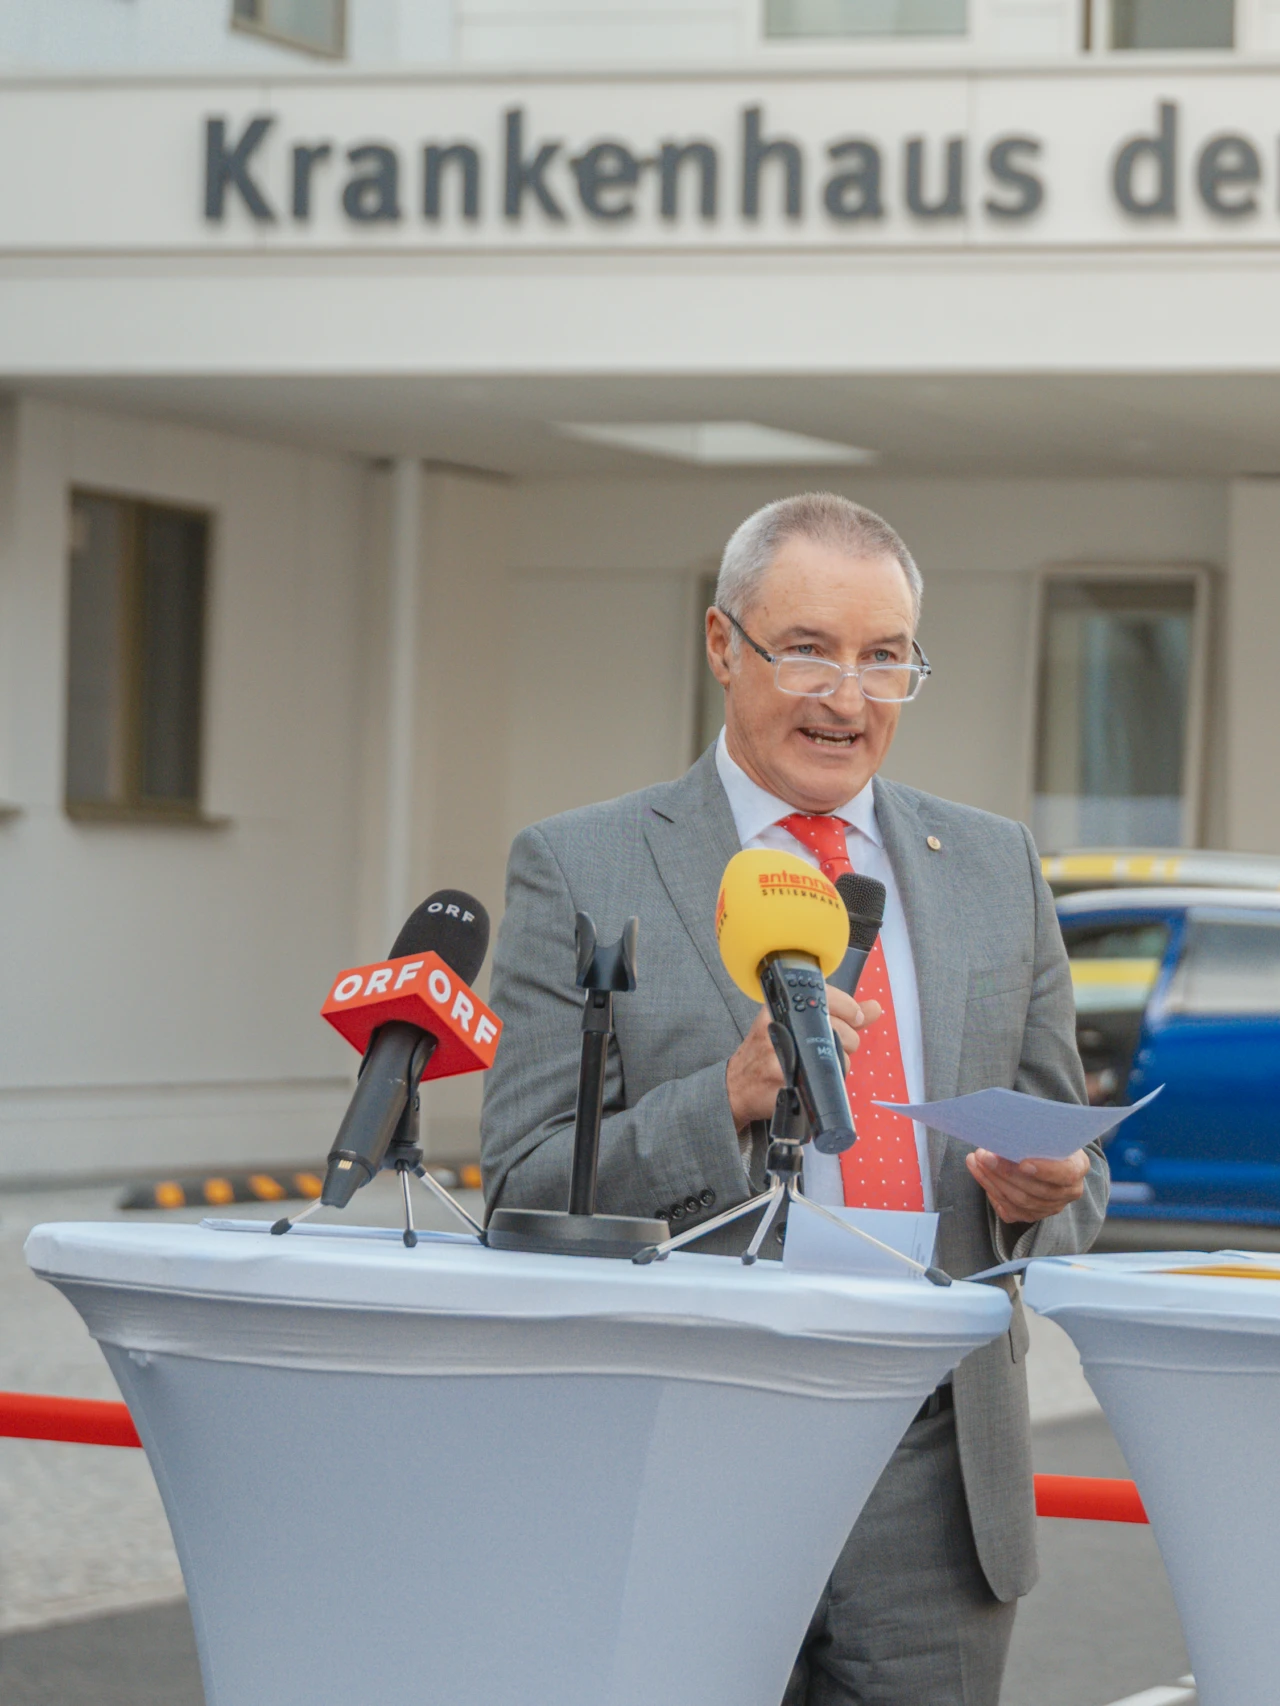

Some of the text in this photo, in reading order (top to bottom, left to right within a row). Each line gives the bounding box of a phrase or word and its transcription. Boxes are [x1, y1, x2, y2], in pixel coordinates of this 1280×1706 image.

[203, 102, 1043, 223] Krankenhaus
[427, 902, 476, 922] ORF
[761, 888, 840, 910] STEIERMARK
[333, 960, 425, 1003] ORF
[428, 969, 498, 1045] ORF
